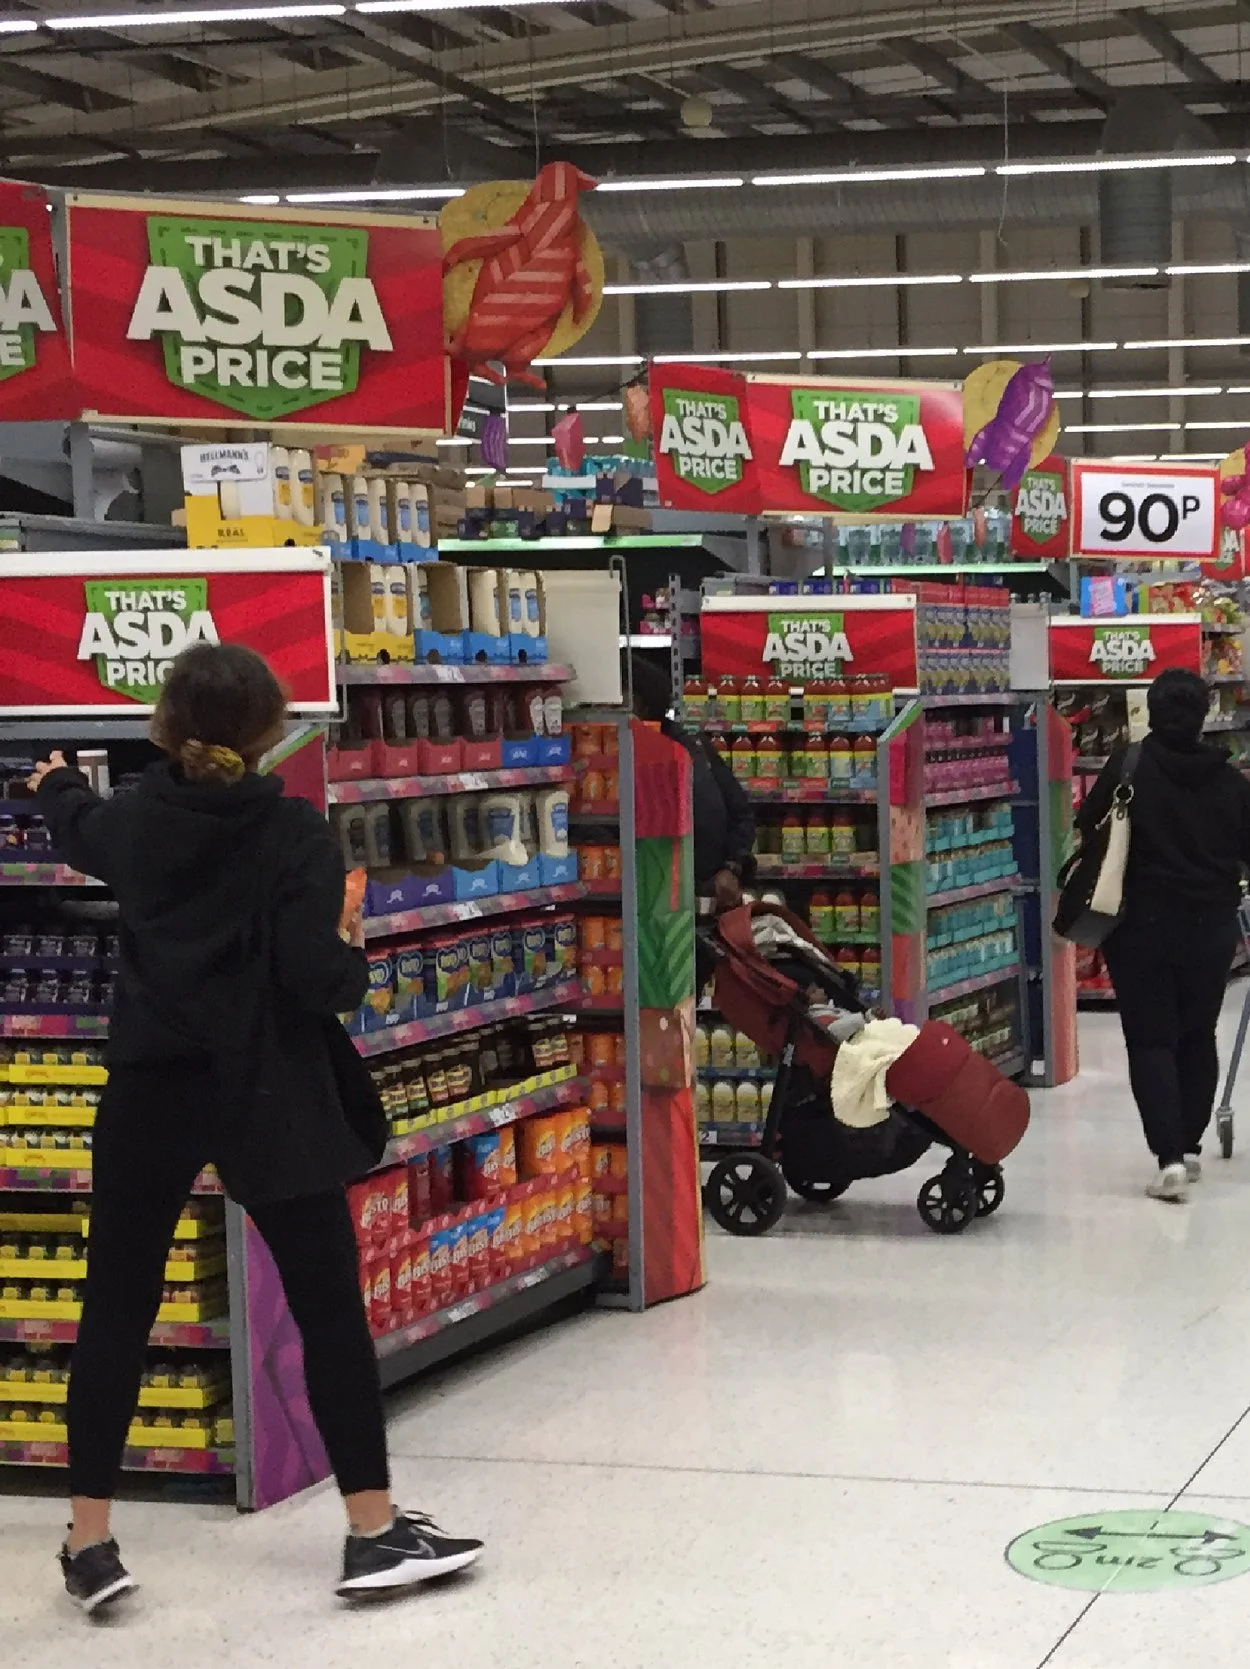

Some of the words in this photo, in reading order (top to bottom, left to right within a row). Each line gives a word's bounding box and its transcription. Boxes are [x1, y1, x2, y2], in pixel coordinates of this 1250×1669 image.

[185, 235, 332, 273] THAT'S
[126, 266, 394, 352] ASDA
[180, 345, 345, 390] PRICE
[676, 398, 727, 420] THAT'S
[814, 400, 898, 423] THAT'S
[659, 413, 753, 460] ASDA
[779, 419, 935, 471] ASDA
[679, 456, 738, 480] PRICE
[809, 468, 904, 496] PRICE
[1027, 477, 1056, 491] THAT'S
[1015, 488, 1067, 520] ASDA
[1024, 517, 1058, 534] PRICE
[105, 590, 188, 611] THAT'S
[780, 619, 831, 633] THAT'S
[762, 631, 854, 662] ASDA
[1088, 639, 1157, 662] ASDA
[106, 660, 175, 687] PRIC
[780, 661, 836, 679] PRICE
[1101, 660, 1144, 674] PRICE
